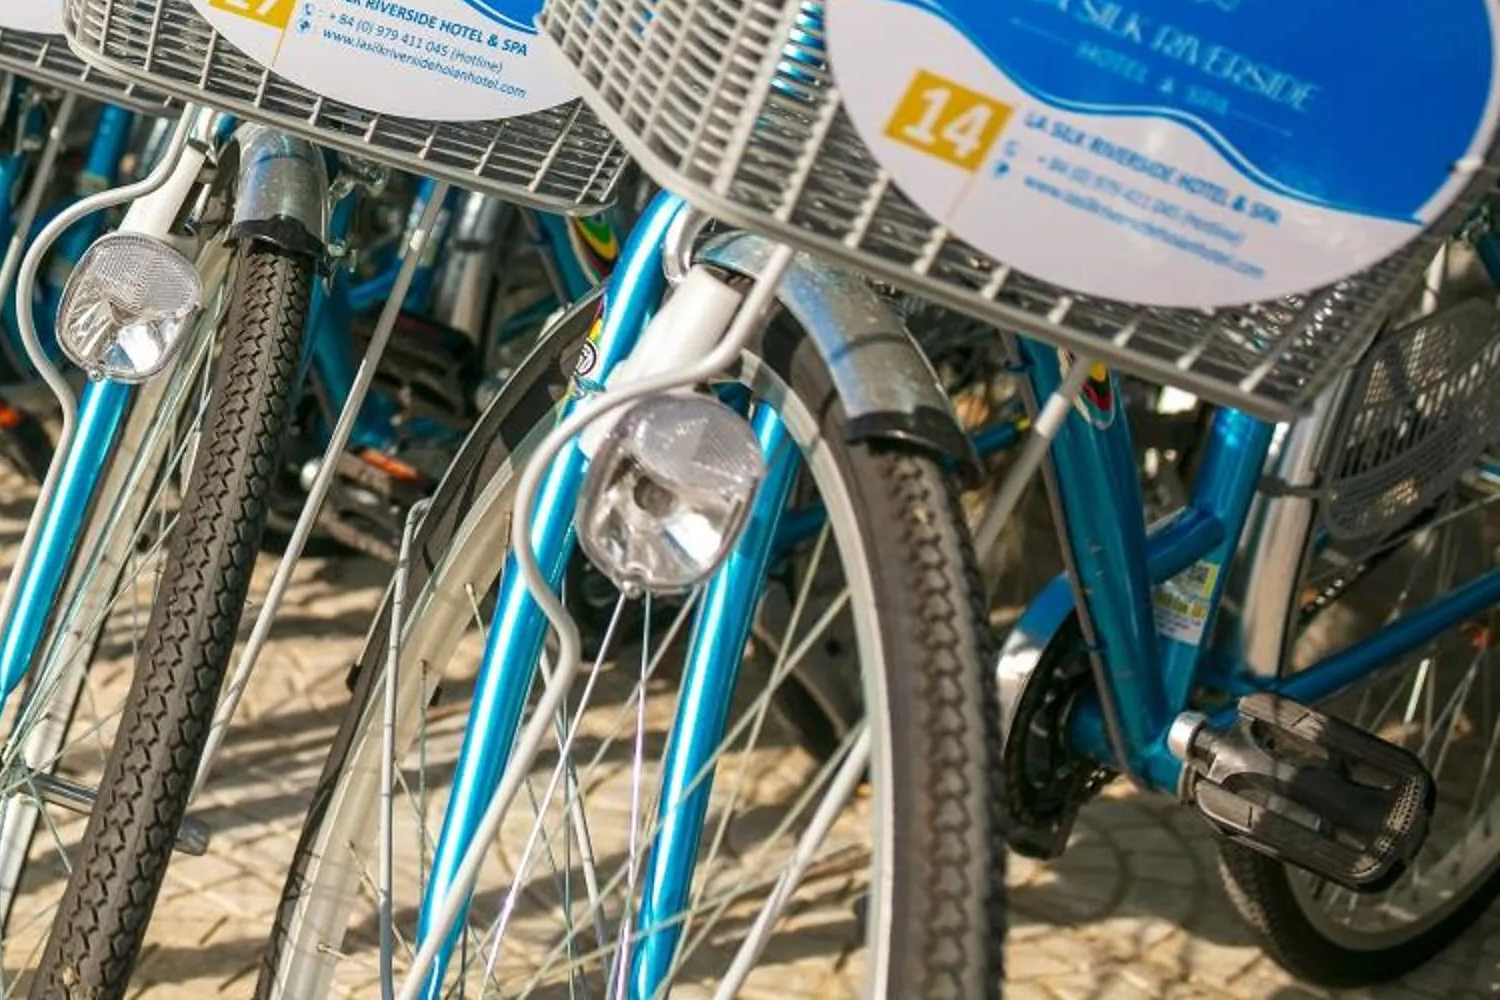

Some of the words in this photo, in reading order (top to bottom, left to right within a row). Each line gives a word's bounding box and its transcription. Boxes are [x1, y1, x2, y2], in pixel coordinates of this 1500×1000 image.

[338, 13, 355, 28] 84
[355, 18, 374, 36] (0)
[376, 25, 399, 41] 979
[401, 33, 423, 50] 411
[426, 40, 449, 57] 045
[451, 48, 503, 75] (Hotline)
[439, 18, 483, 44] HOTEL
[486, 33, 498, 48] &
[502, 38, 529, 56] SPA
[1150, 23, 1321, 111] RIVERSIDE
[902, 87, 996, 159] 14
